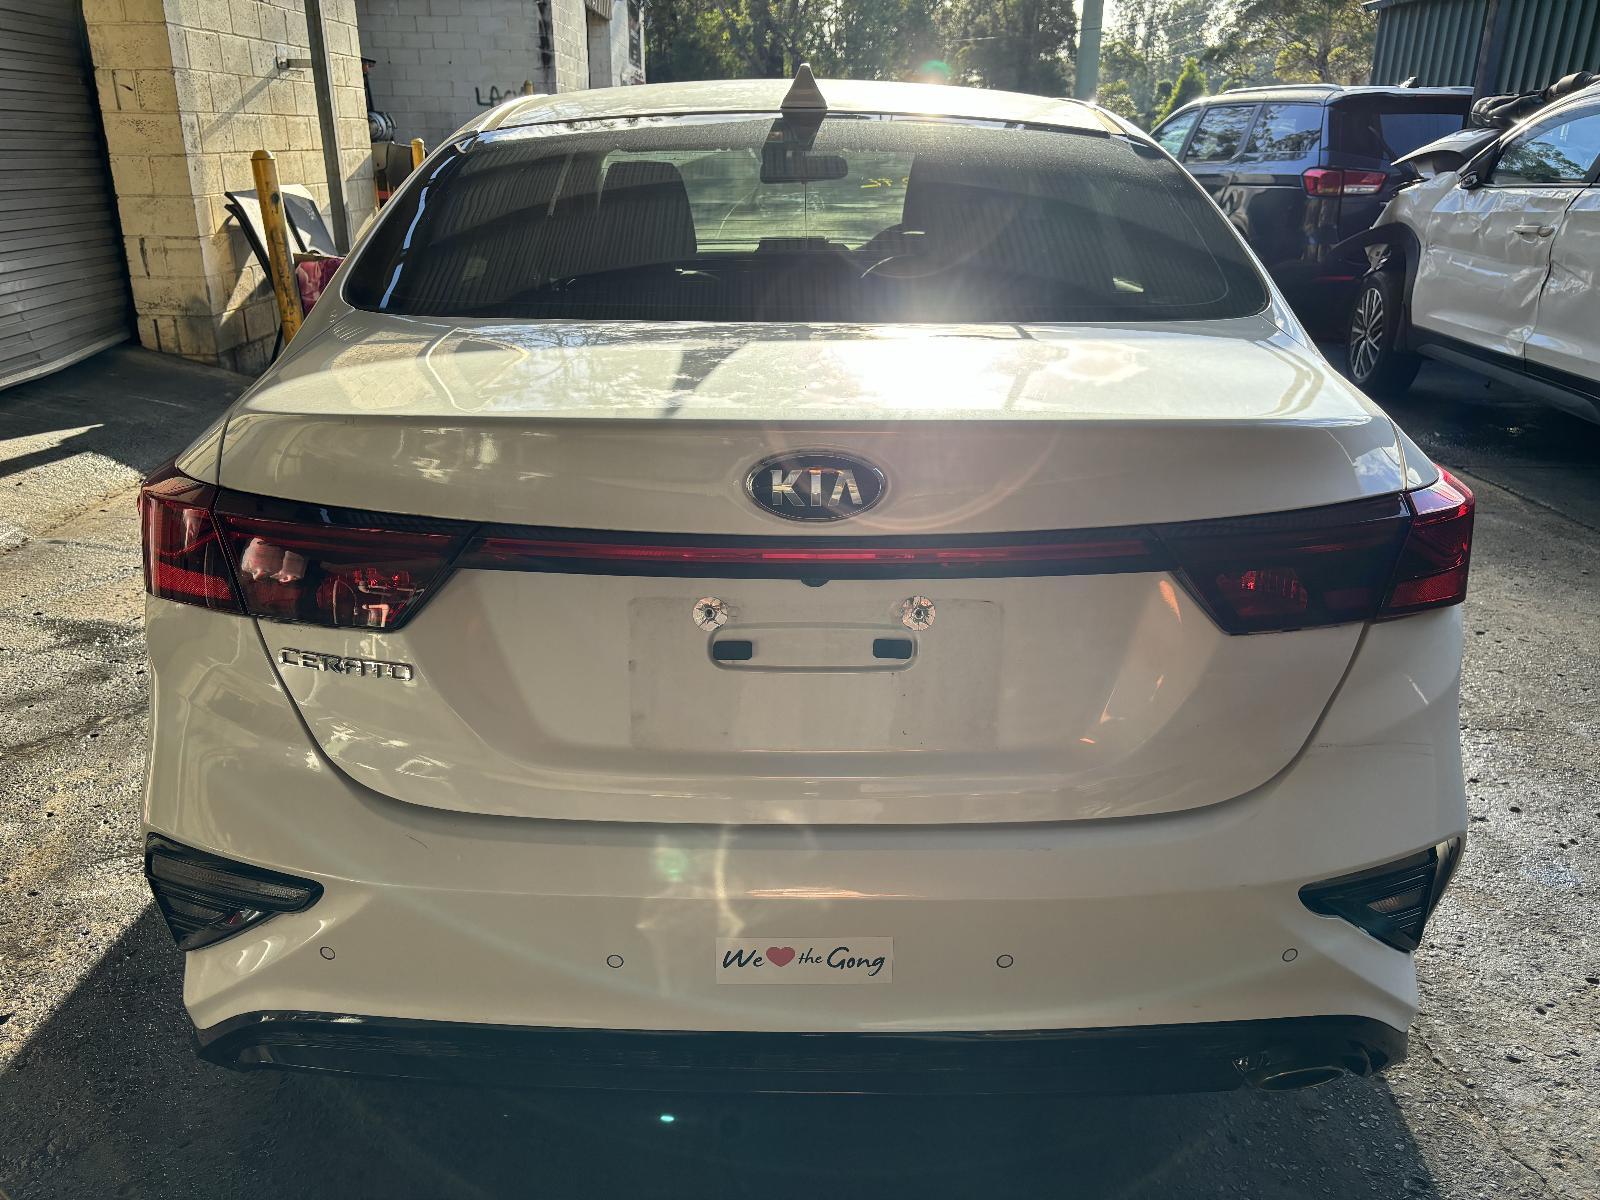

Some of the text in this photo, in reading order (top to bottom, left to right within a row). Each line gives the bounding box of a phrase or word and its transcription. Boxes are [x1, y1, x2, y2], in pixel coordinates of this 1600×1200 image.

[770, 469, 863, 507] KIA
[278, 647, 413, 681] CERATO
[722, 946, 886, 976] We the Gong
